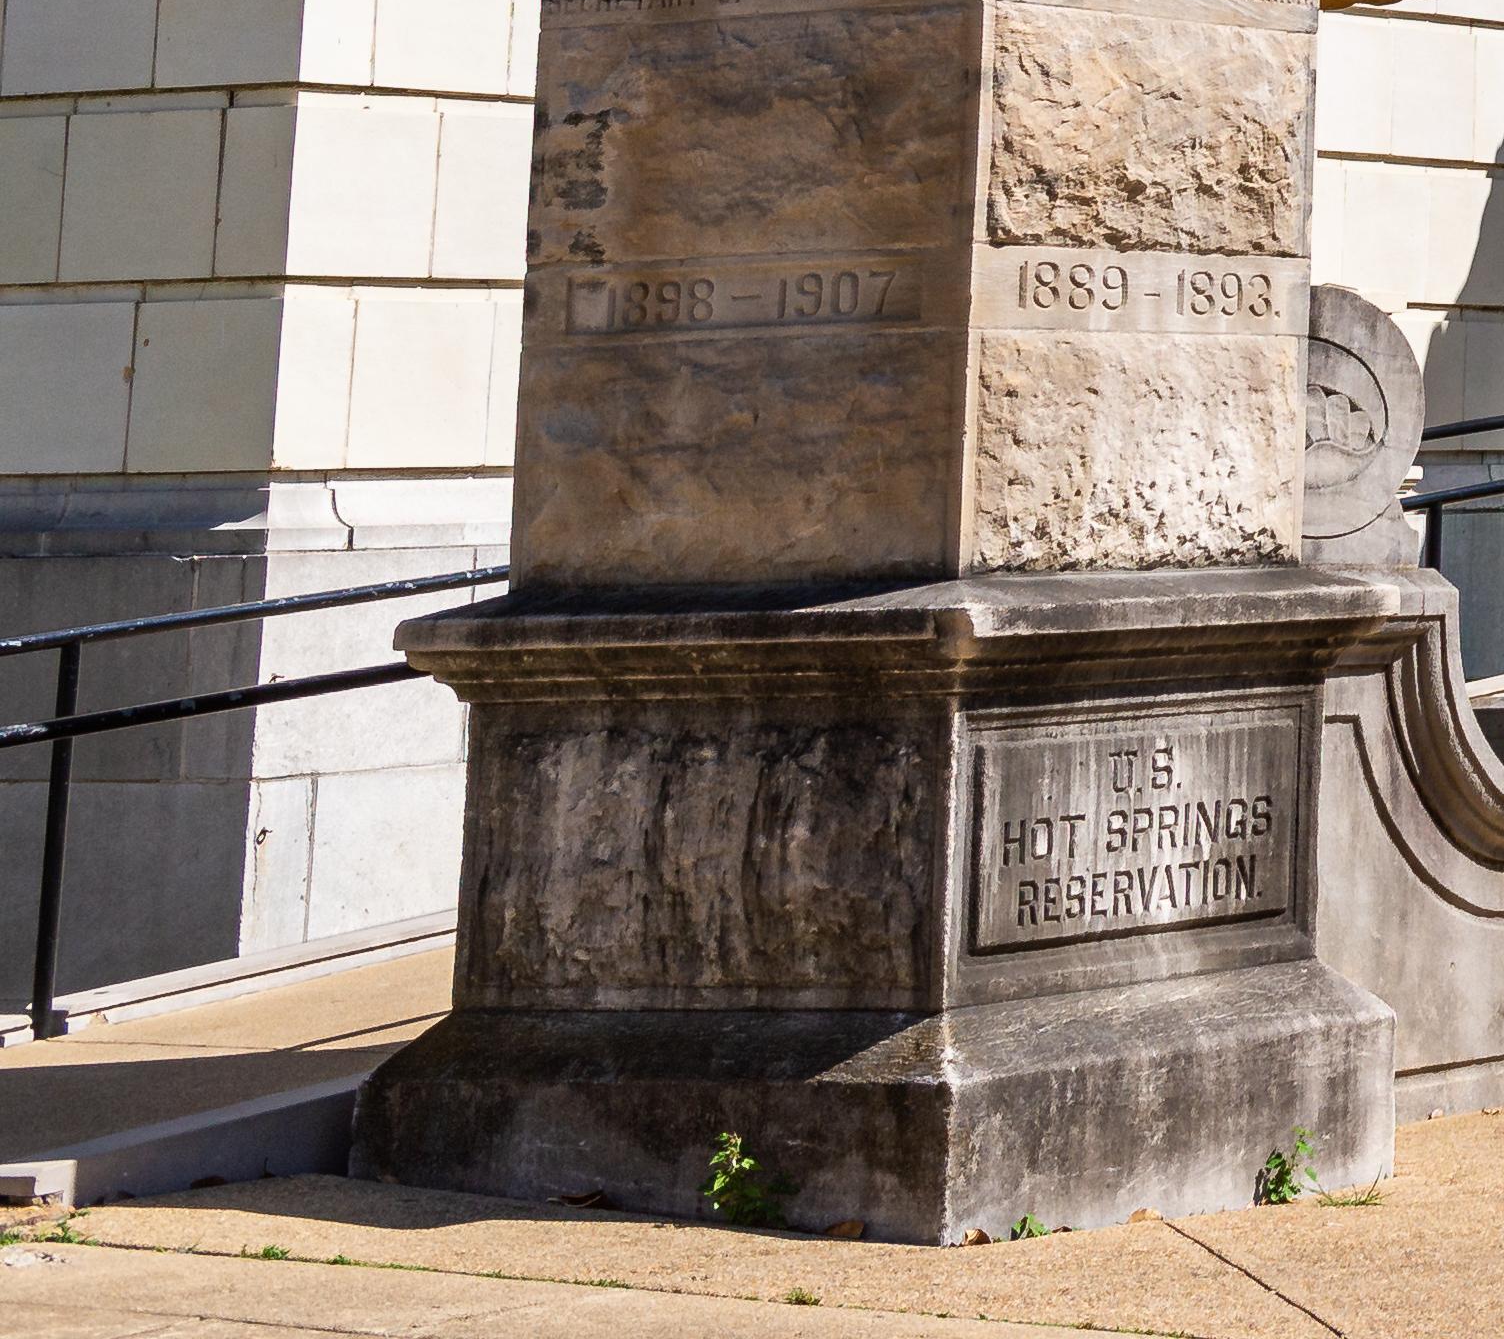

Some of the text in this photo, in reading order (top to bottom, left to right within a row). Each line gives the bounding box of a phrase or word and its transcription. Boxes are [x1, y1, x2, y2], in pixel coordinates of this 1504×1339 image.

[605, 277, 714, 331] 1898
[776, 270, 896, 320] 1907
[1018, 260, 1129, 311] 1889
[1002, 795, 1272, 867] HOT SPRINGS
